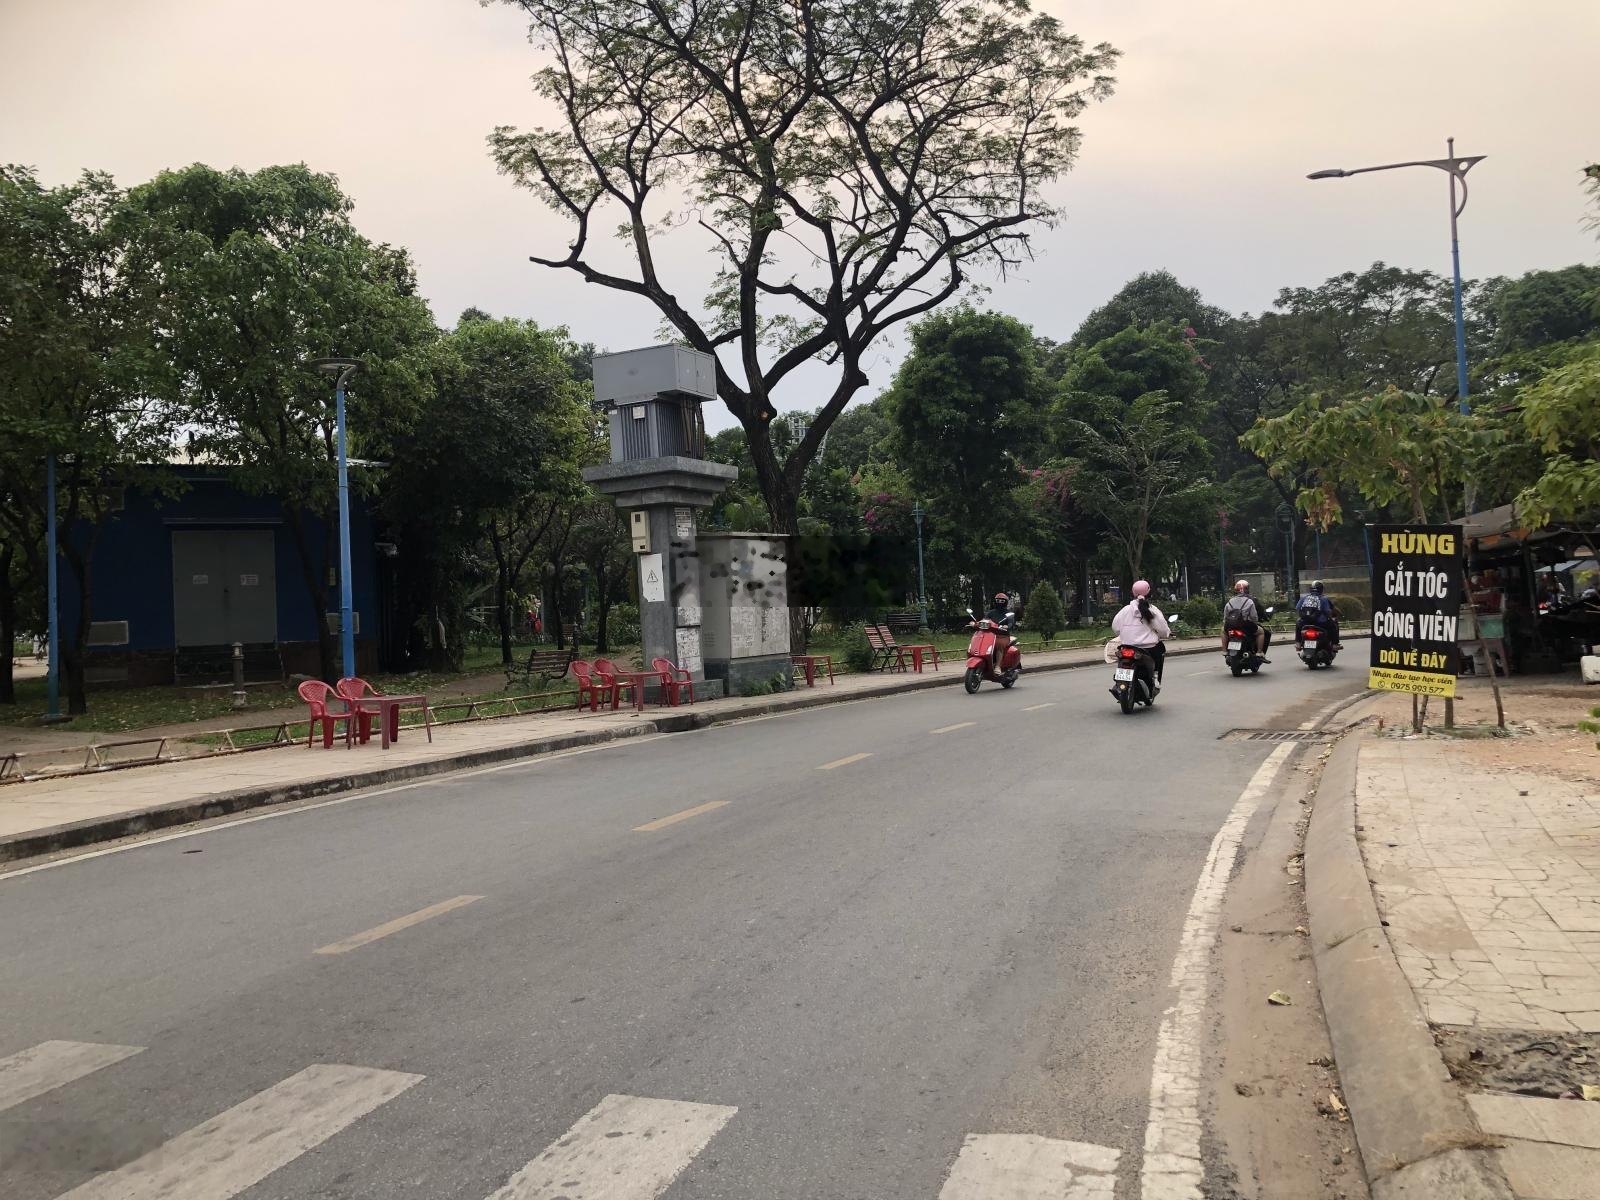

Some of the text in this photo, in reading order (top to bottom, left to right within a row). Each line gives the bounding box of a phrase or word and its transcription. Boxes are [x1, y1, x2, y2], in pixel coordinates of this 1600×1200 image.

[1381, 529, 1455, 555] HÙNG
[1384, 561, 1448, 599] CẮT TÓC
[1373, 606, 1457, 642] CÔNG VIÊN
[1379, 647, 1447, 669] DỜI VỀ ĐÂY
[1390, 682, 1445, 694] 0975 993 577
